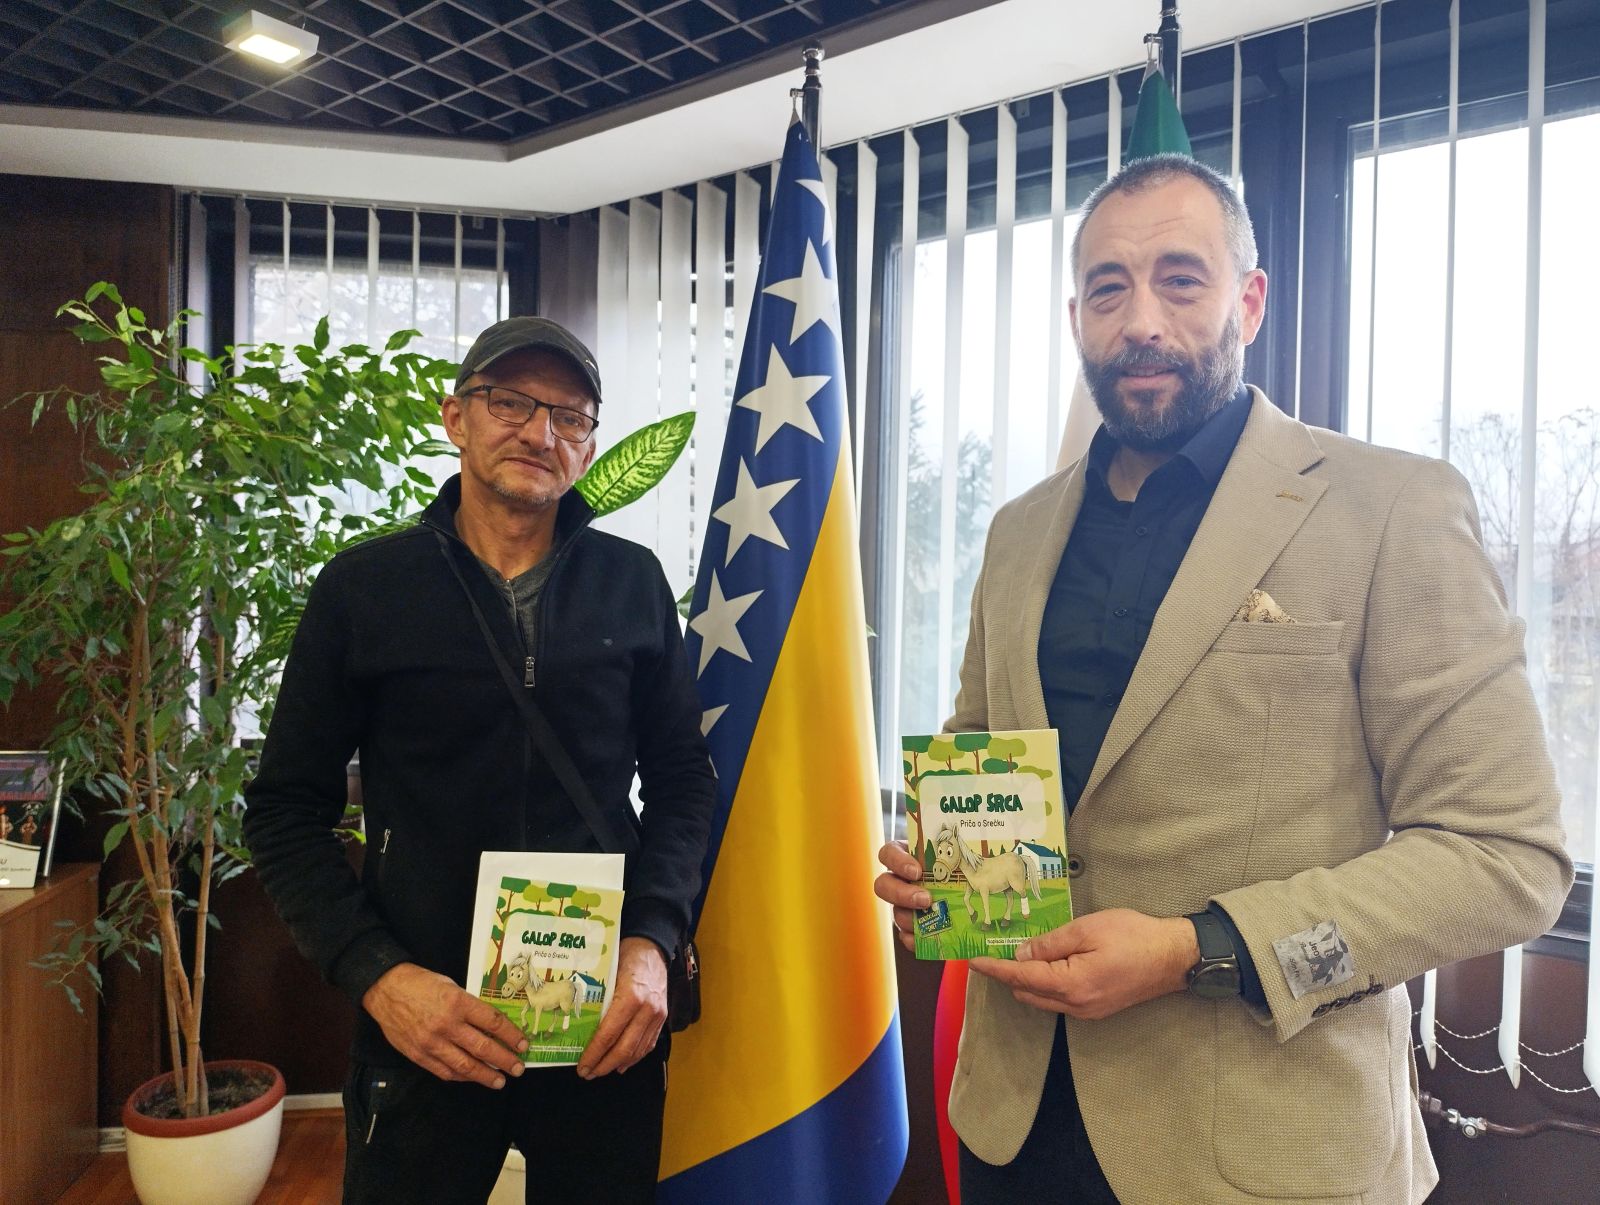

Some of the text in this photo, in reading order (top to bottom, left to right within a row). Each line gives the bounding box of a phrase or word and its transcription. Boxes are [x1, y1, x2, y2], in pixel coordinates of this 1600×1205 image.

[940, 793, 1023, 813] GALOP SRCA
[521, 930, 586, 949] GALOP SRCA
